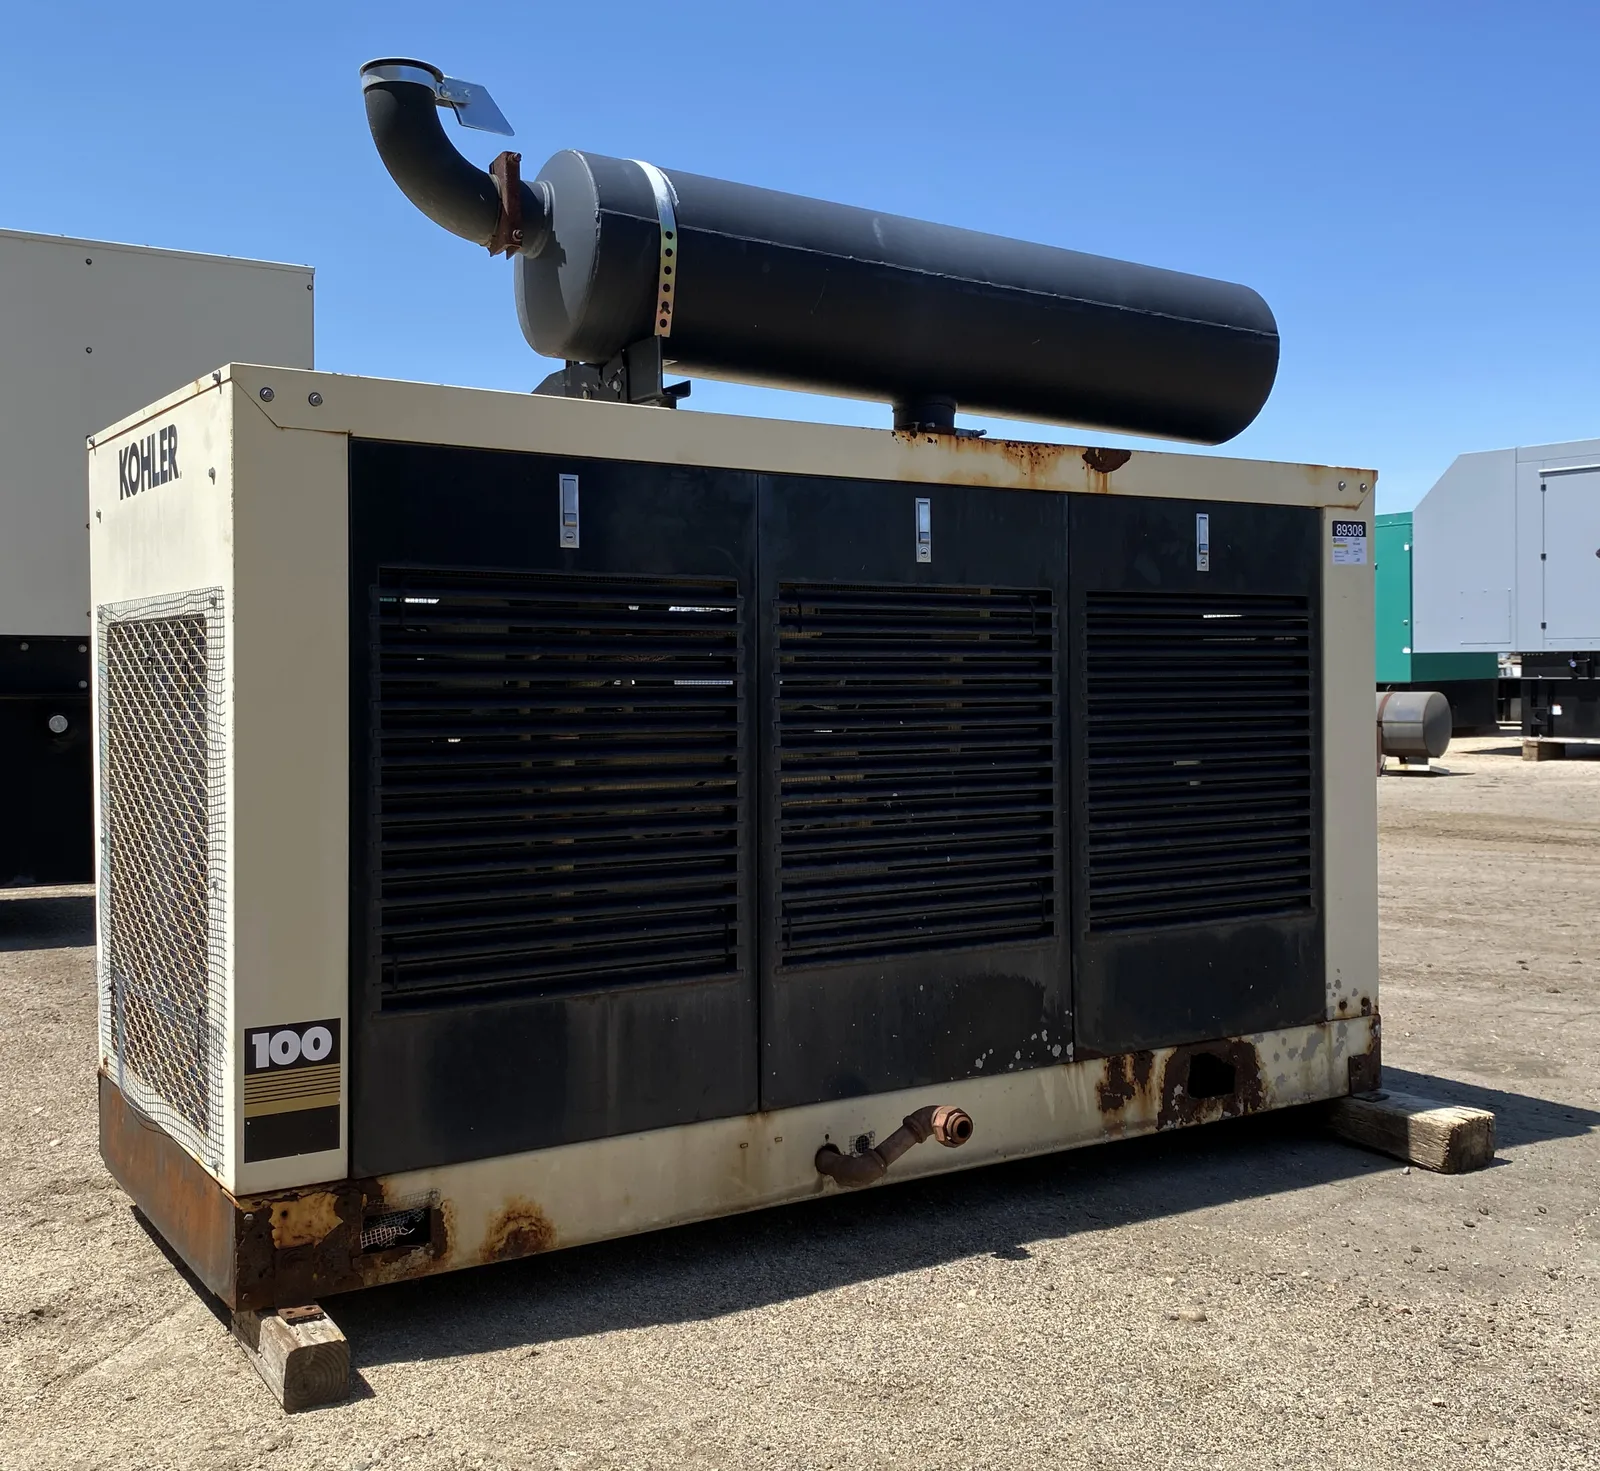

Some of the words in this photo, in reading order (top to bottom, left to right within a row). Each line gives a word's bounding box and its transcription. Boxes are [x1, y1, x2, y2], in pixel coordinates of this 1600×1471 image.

[119, 424, 179, 500] KOHLER
[1336, 524, 1364, 537] 89308
[252, 1026, 333, 1069] 100
